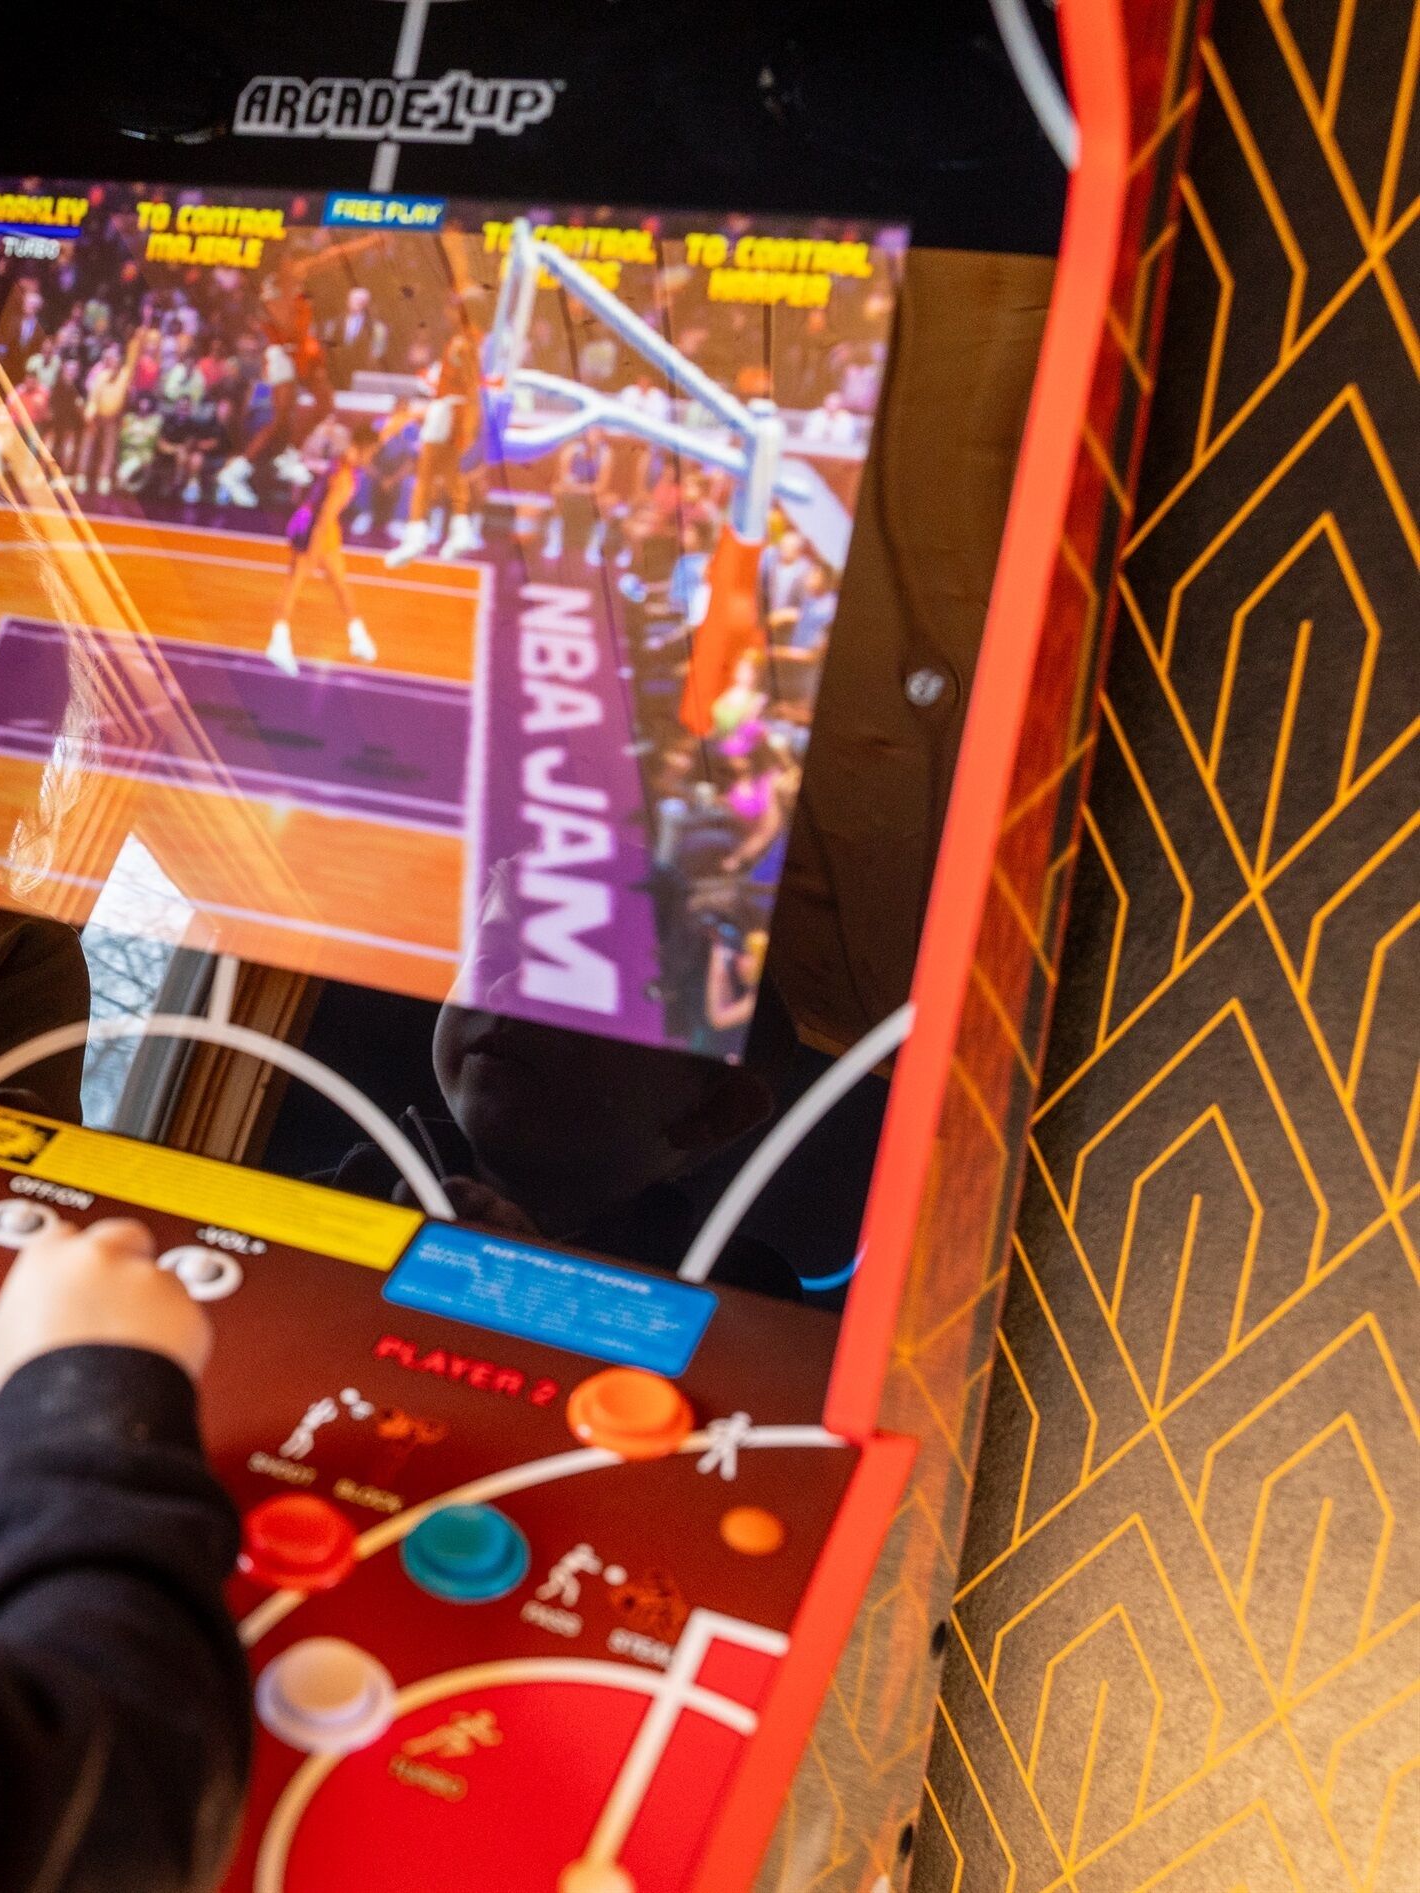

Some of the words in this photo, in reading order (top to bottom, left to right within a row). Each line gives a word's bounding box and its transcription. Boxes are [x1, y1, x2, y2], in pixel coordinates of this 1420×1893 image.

[136, 201, 172, 233] TO
[175, 203, 286, 240] CONTROL
[332, 198, 385, 224] FREE
[384, 200, 444, 226] PLAY
[684, 232, 729, 268] TO
[733, 235, 873, 279] CONTROL
[518, 583, 604, 735] NBA
[518, 746, 620, 1016] JAM
[373, 1334, 525, 1397] PLAYER
[529, 1376, 561, 1407] 2
